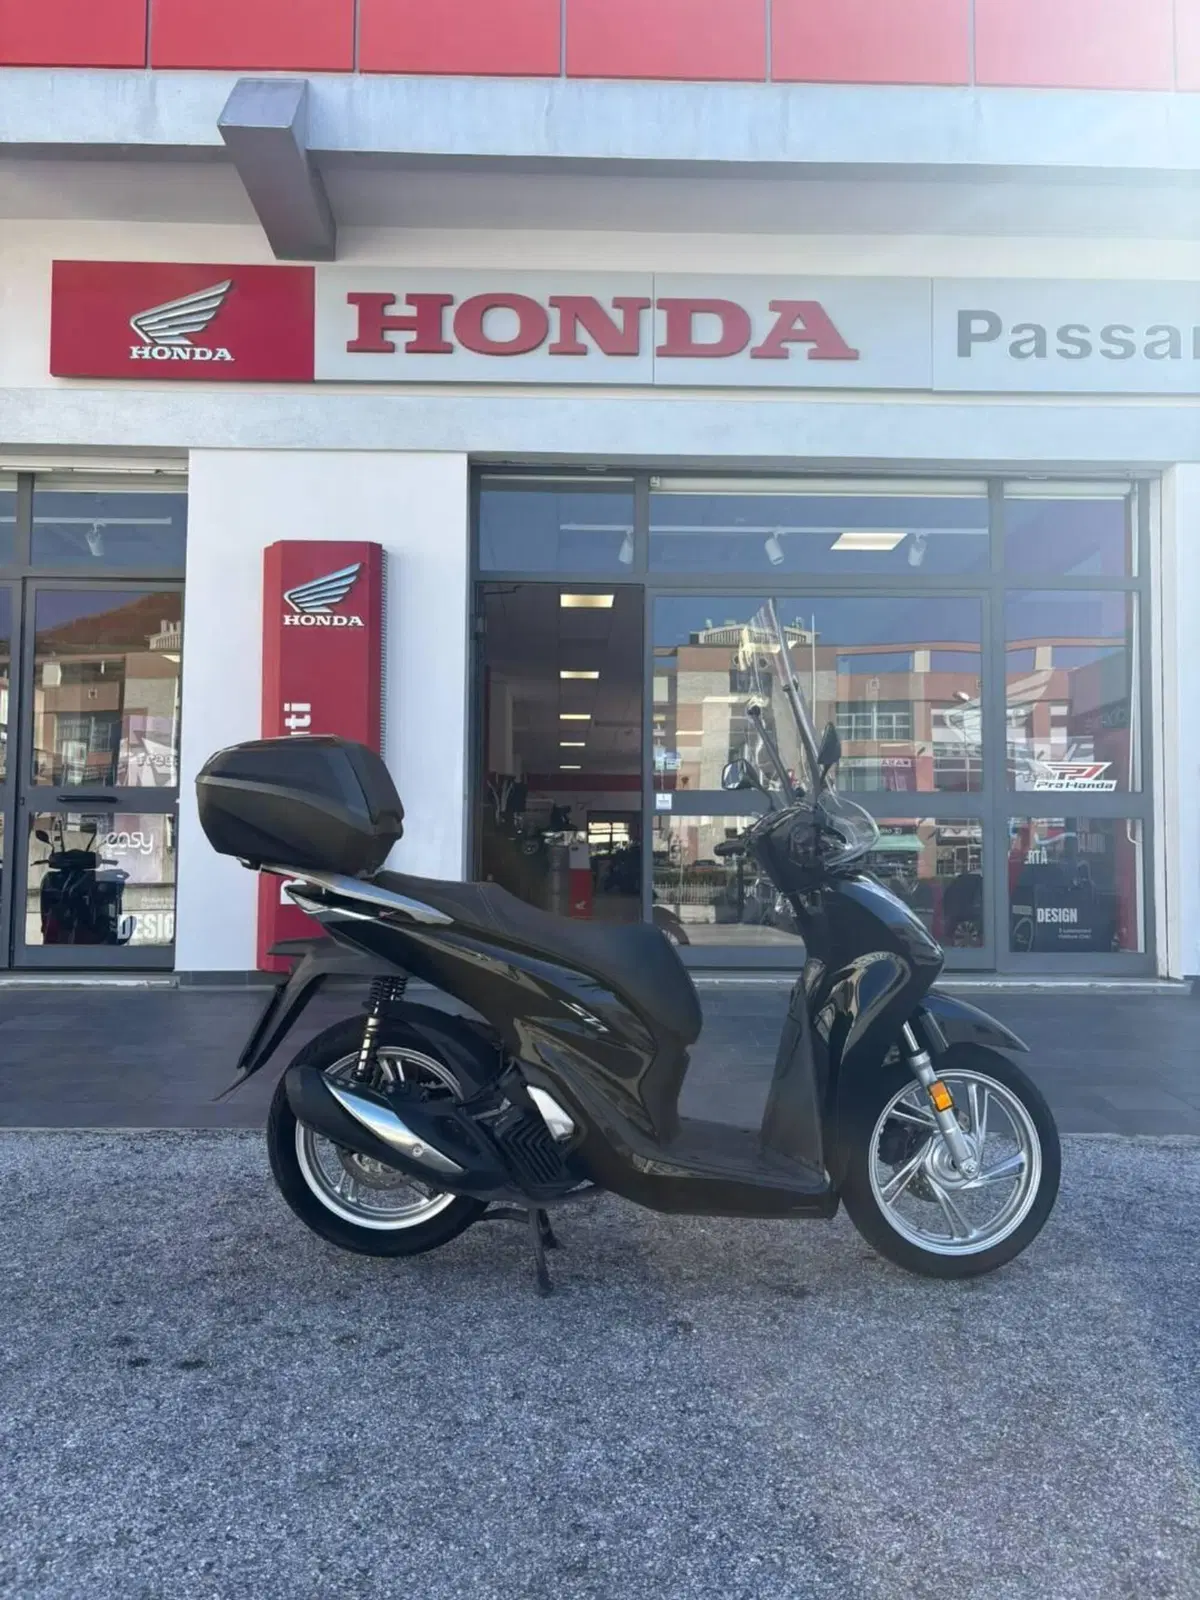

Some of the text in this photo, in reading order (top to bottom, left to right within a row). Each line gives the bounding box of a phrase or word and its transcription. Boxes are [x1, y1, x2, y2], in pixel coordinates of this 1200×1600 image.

[346, 292, 1200, 361] HONDA Passa
[129, 346, 235, 361] HONDA
[283, 614, 365, 626] HONDA
[106, 831, 153, 855] easy
[1037, 907, 1078, 923] DESIGN
